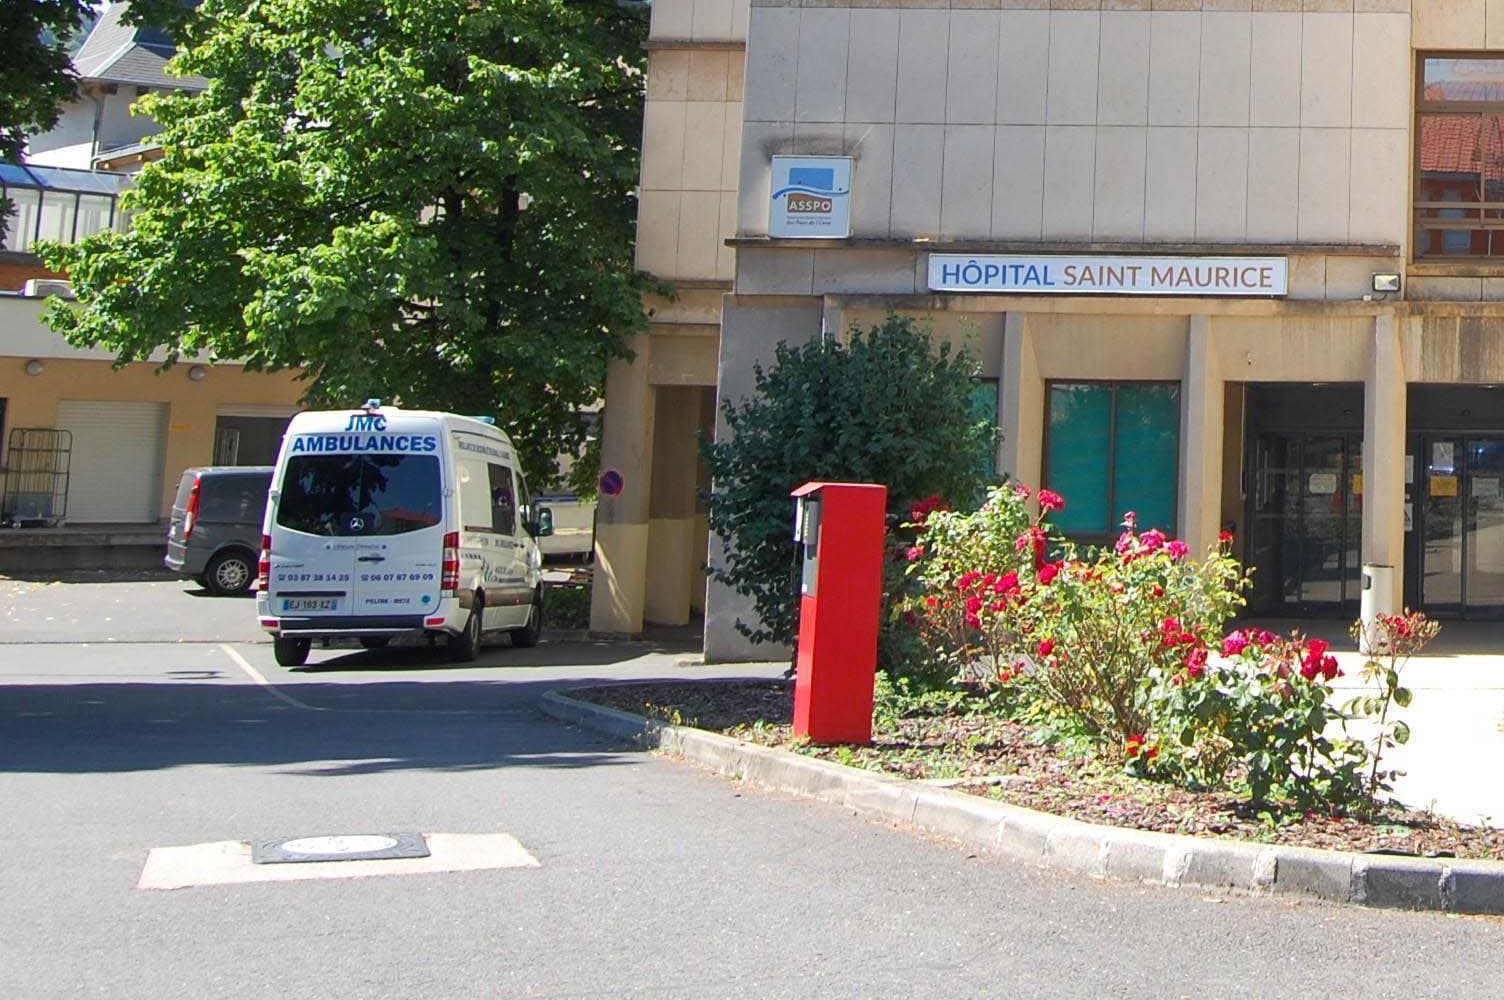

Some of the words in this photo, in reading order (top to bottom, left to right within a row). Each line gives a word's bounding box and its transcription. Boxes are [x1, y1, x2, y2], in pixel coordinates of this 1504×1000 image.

[788, 200, 831, 211] ASSPO
[942, 259, 1055, 286] HÔPITAL
[1063, 264, 1143, 287] SAINT
[1151, 266, 1273, 288] MAURICE
[344, 415, 387, 431] JMC
[292, 436, 437, 452] AMBULANCES
